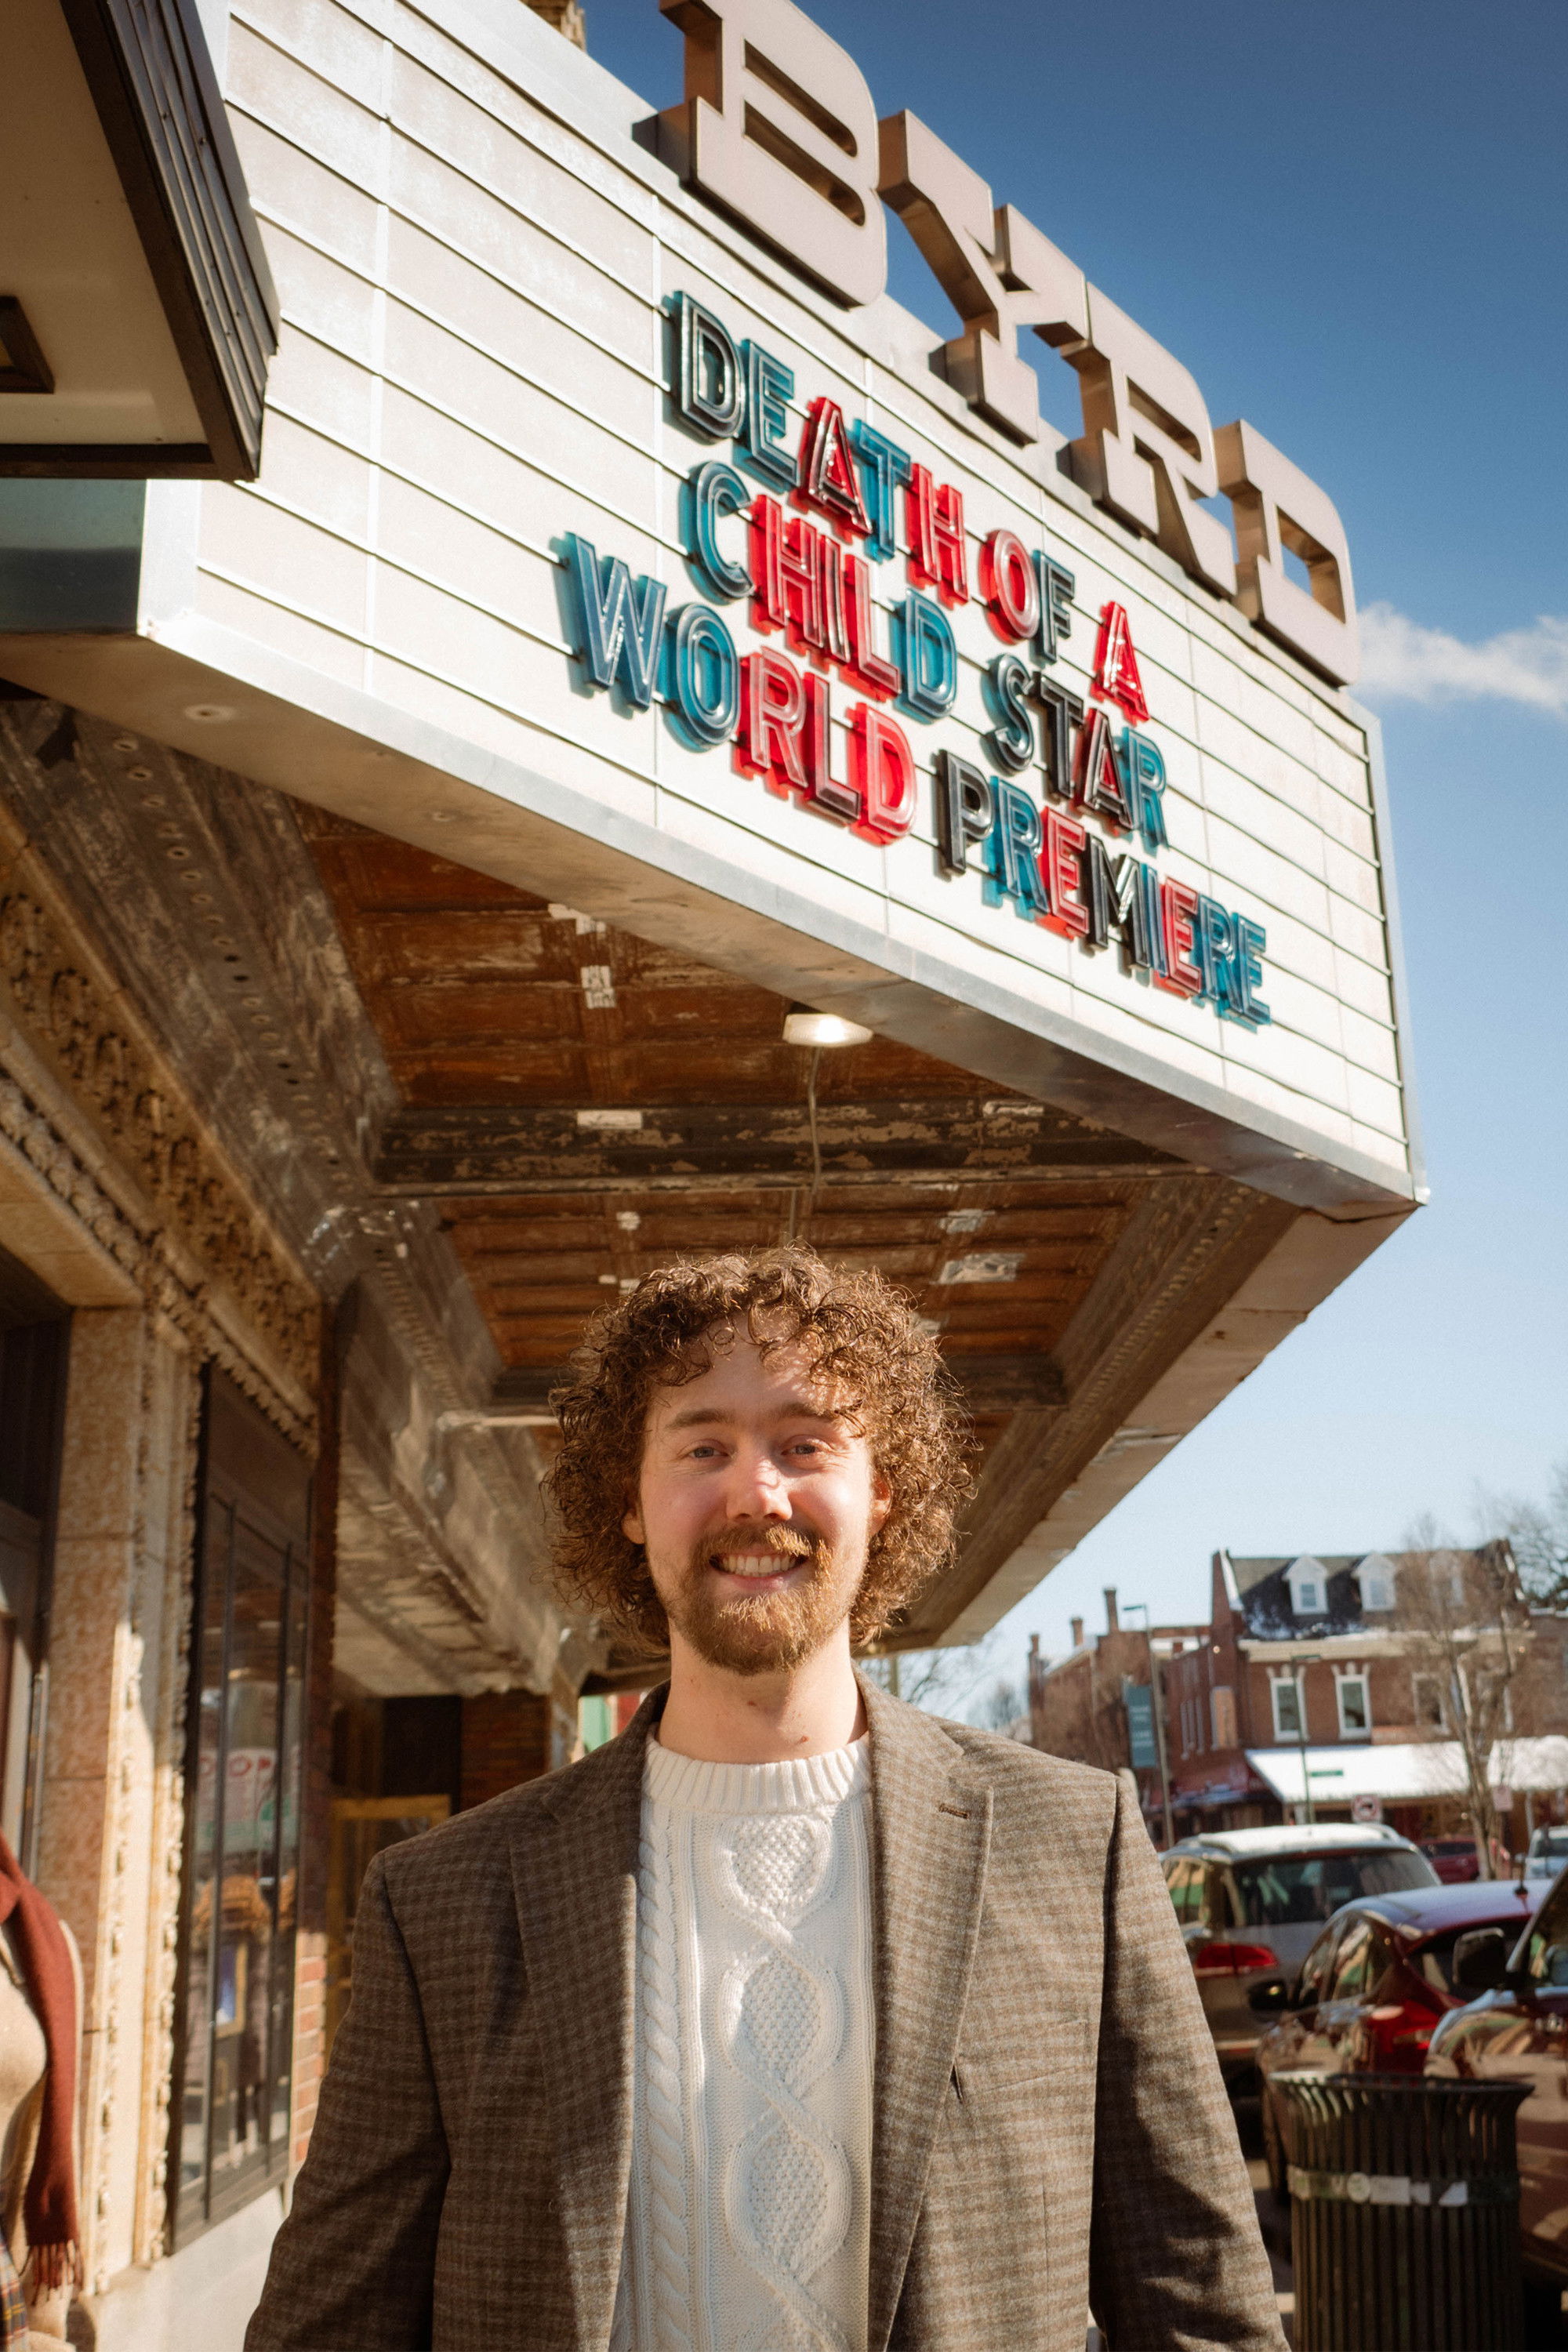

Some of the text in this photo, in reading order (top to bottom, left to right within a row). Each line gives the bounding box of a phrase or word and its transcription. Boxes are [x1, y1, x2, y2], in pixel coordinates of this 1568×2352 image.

[633, 0, 1359, 687] BYRD
[670, 289, 1150, 723] DEATH OF A
[555, 530, 1271, 1029] WORLD PREMIERE
[682, 460, 1169, 850] CHILD STAR
